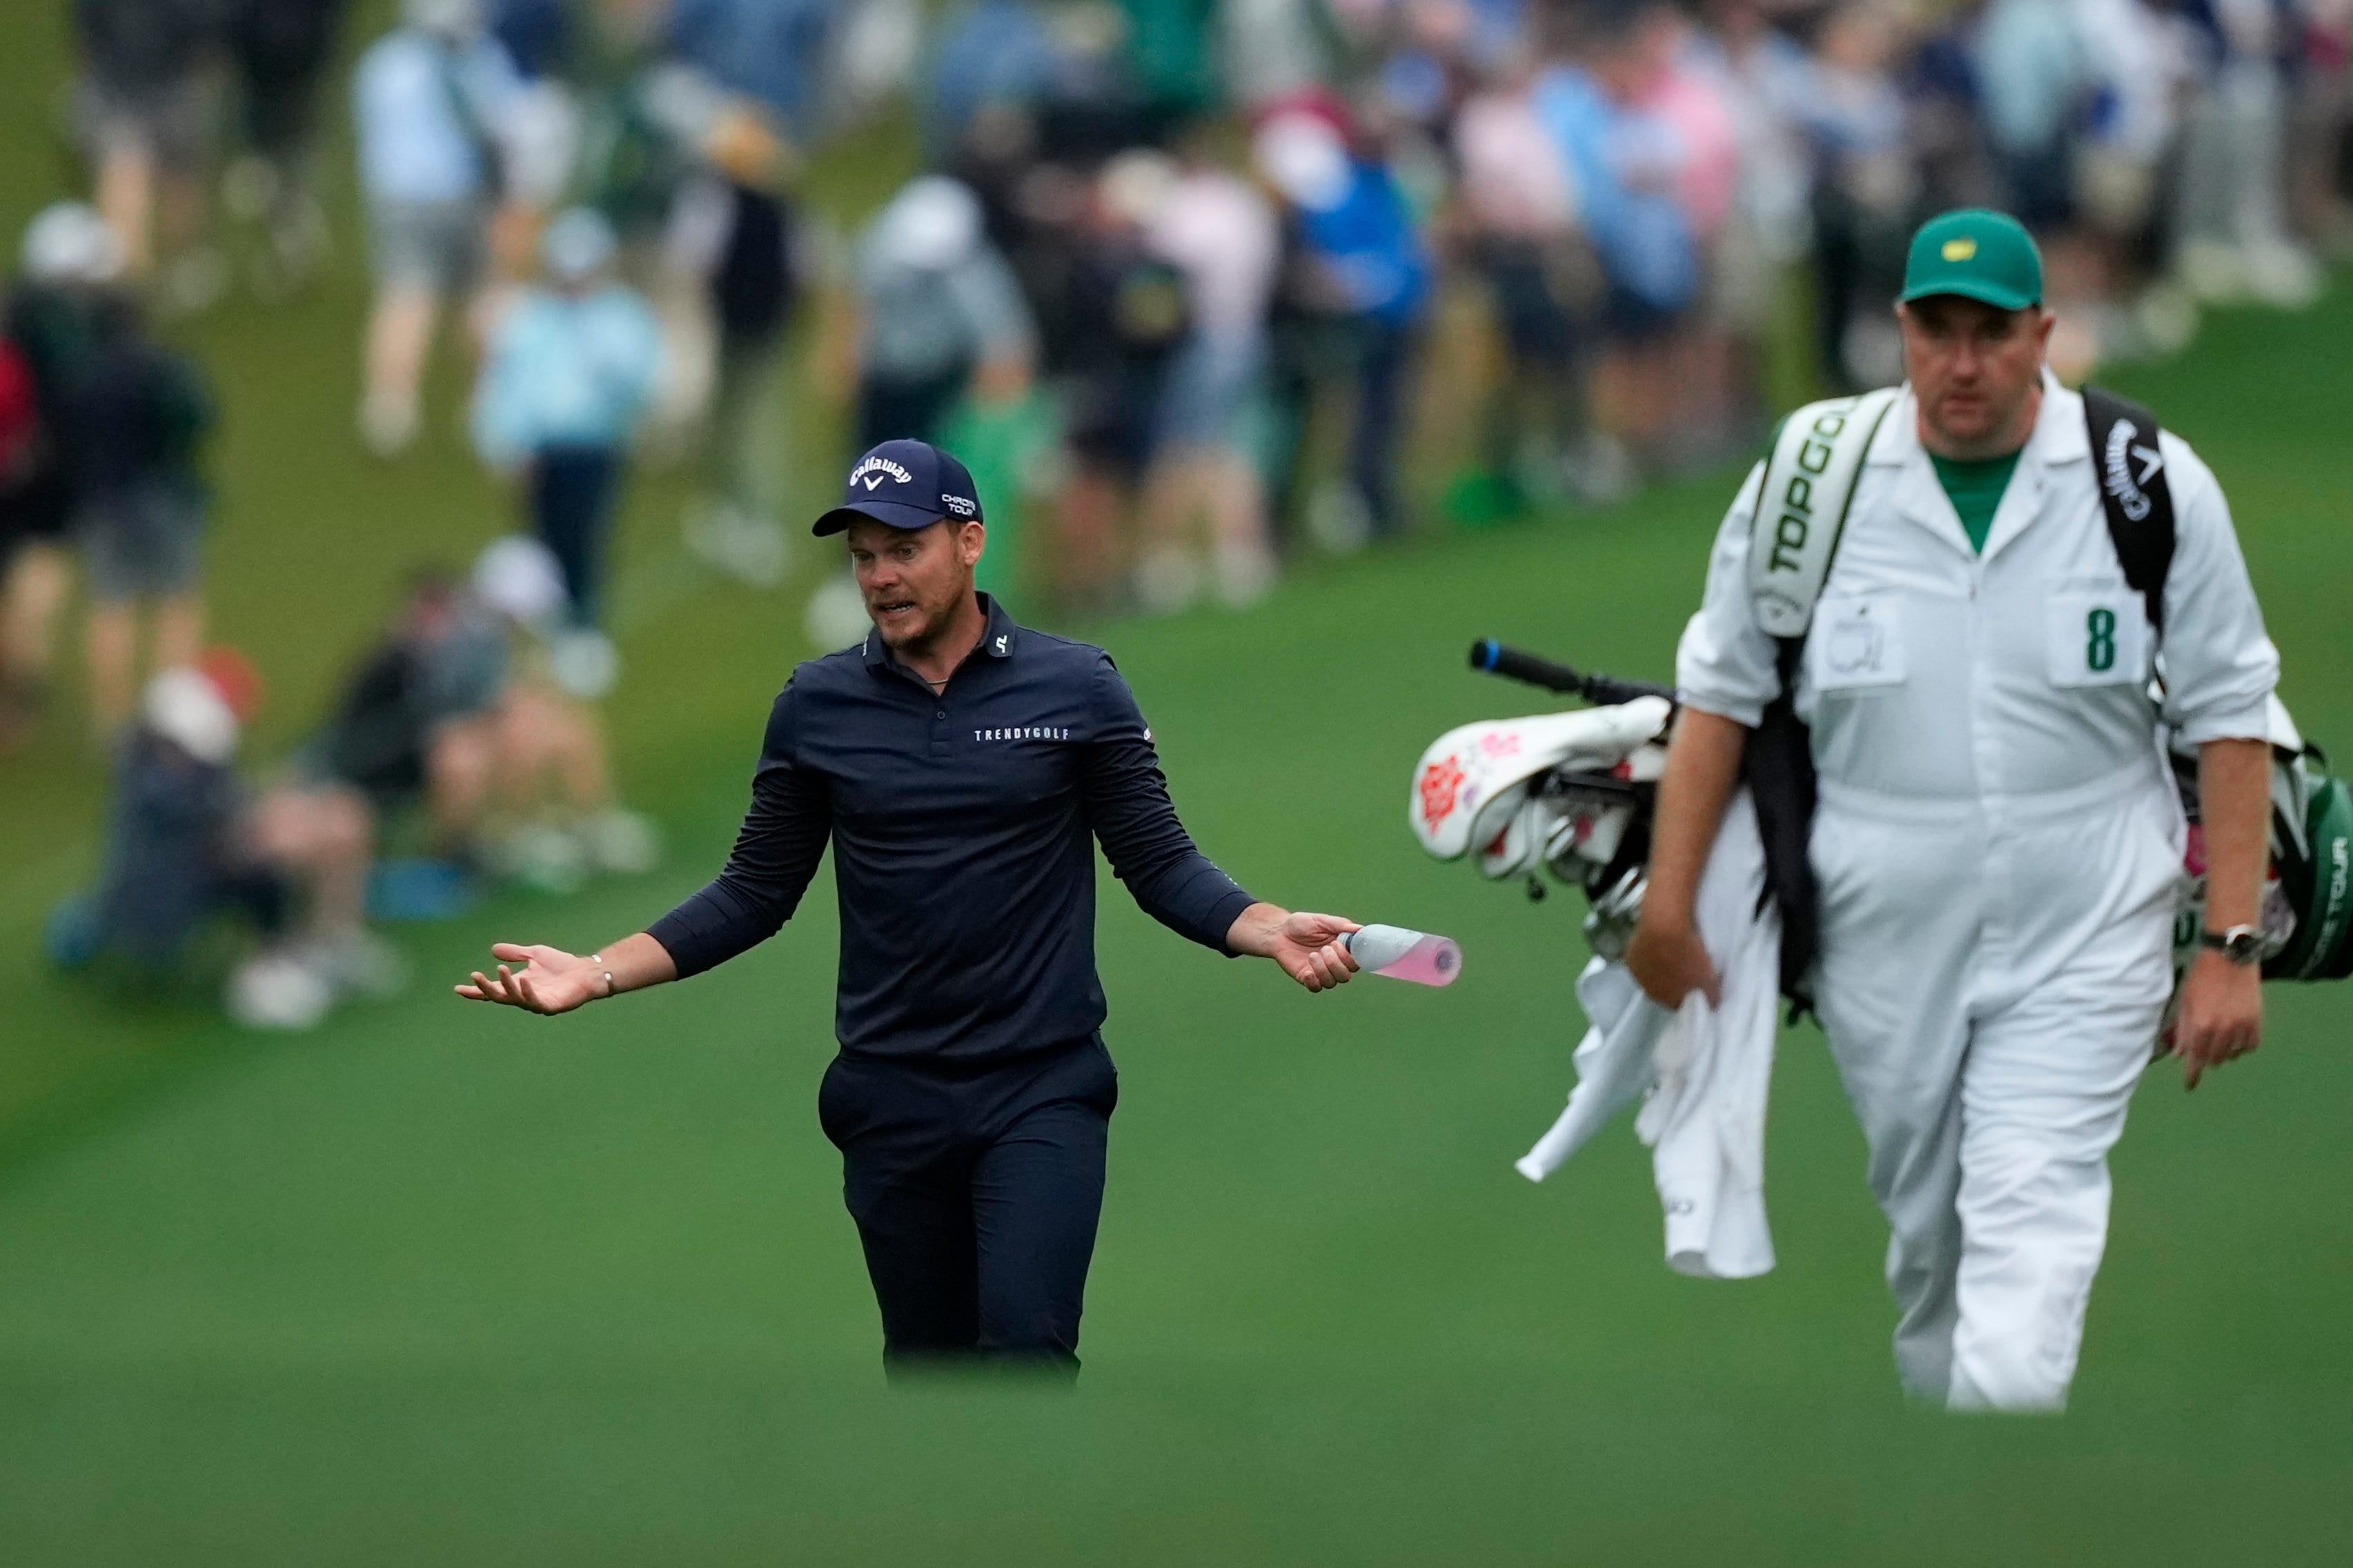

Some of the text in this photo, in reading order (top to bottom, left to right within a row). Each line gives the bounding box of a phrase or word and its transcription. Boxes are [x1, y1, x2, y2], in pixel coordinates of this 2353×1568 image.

[849, 456, 912, 486] Callaway
[948, 503, 973, 517] TOUR
[2087, 608, 2115, 671] 8
[974, 726, 1069, 742] TRENDYGOLF
